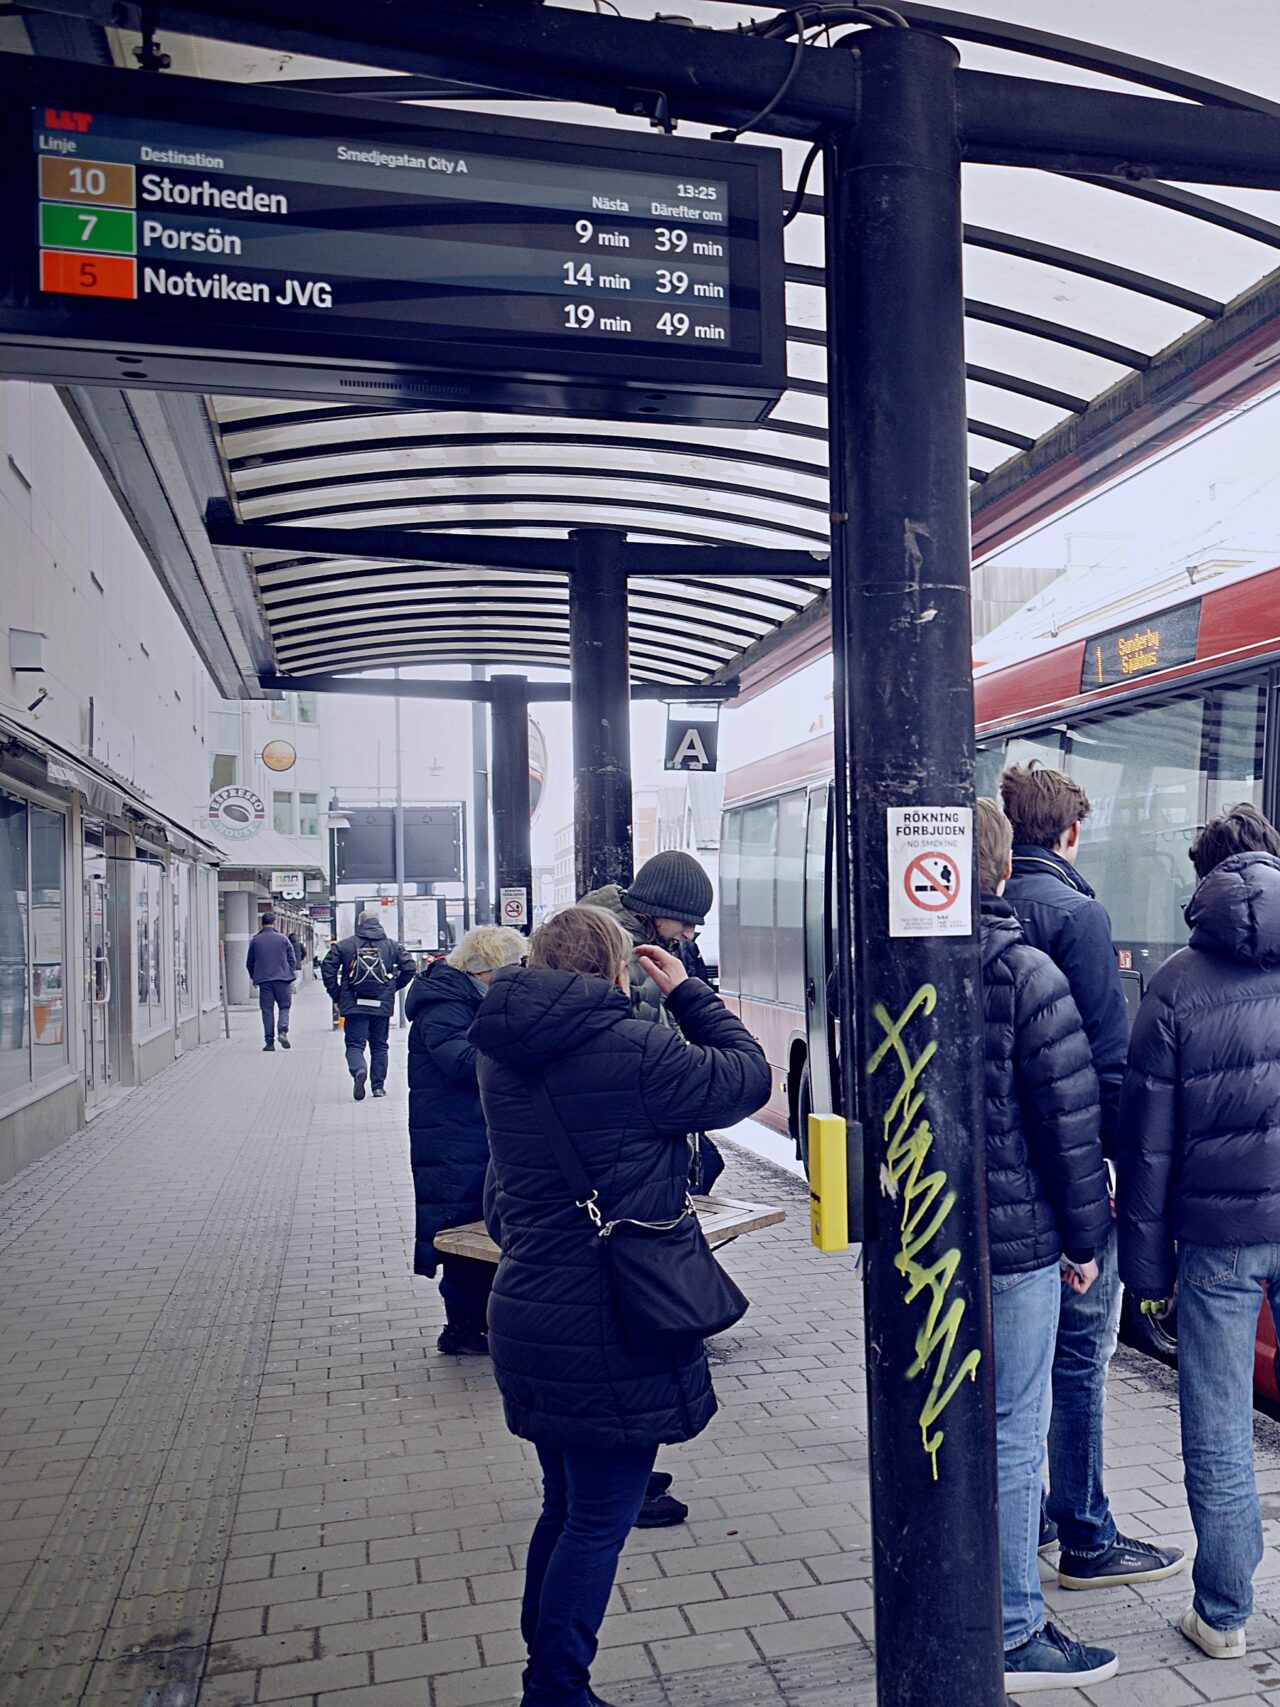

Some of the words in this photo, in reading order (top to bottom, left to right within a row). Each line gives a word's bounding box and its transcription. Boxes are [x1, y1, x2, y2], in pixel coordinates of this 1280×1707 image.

[44, 108, 93, 133] LLT
[39, 135, 77, 154] Linje
[140, 147, 224, 169] Destination
[337, 147, 426, 169] Smedjegatan
[427, 156, 455, 174] City
[456, 160, 468, 173] A
[68, 167, 106, 195] 10
[141, 174, 288, 214] Storheden
[677, 184, 717, 200] 13:25
[592, 196, 629, 212] Nästa
[651, 203, 701, 220] Därefter
[702, 210, 723, 222] om
[77, 214, 98, 241] 7
[142, 220, 242, 255] Porsön
[575, 219, 594, 244] 9
[598, 232, 630, 248] min
[654, 227, 689, 253] 39
[692, 241, 723, 257] min
[79, 263, 97, 288] 5
[143, 267, 270, 303] Notviken
[275, 279, 333, 308] JVG
[563, 261, 594, 286] 14
[599, 274, 631, 290] min
[655, 269, 689, 294] 39
[693, 283, 724, 298] min
[564, 304, 595, 329] 19
[600, 316, 632, 332] min
[656, 312, 690, 337] 49
[694, 324, 725, 340] min
[673, 728, 709, 765] A
[211, 789, 263, 810] ESPRESSO
[896, 824, 965, 836] FÖRBJUDEN
[903, 811, 959, 823] RÖKNING
[906, 840, 920, 848] NO
[921, 840, 958, 848] SMOKING
